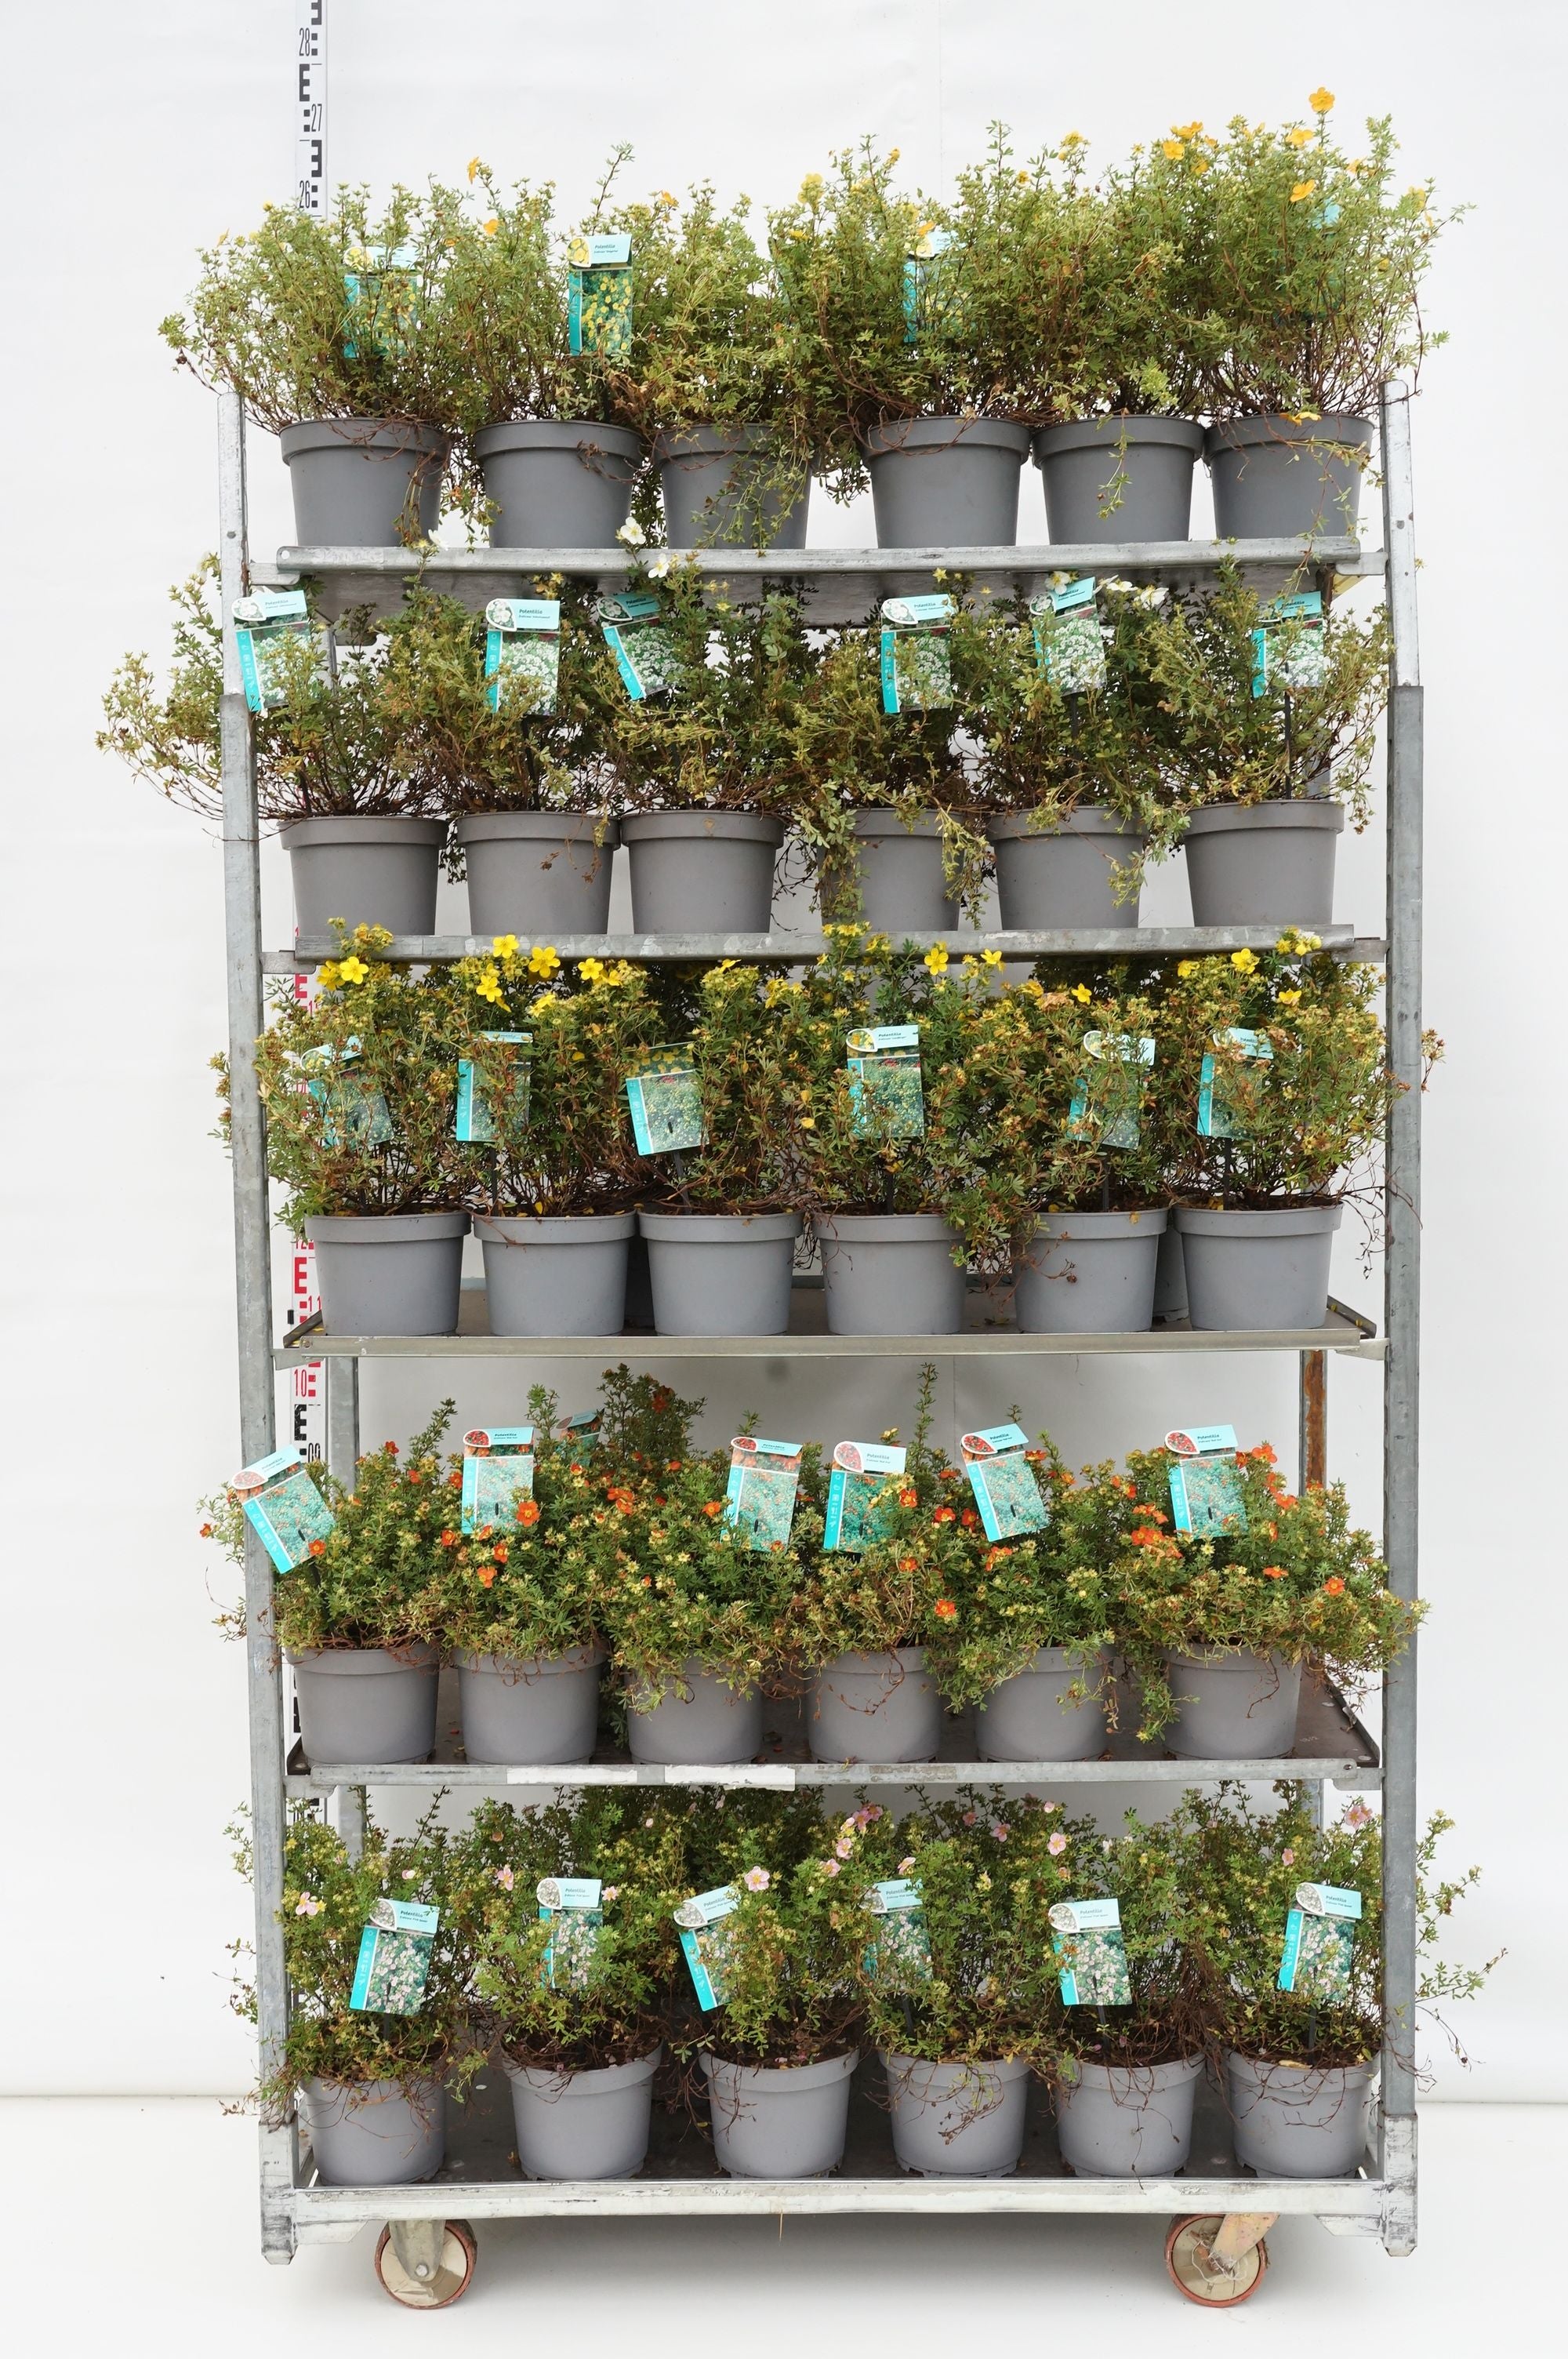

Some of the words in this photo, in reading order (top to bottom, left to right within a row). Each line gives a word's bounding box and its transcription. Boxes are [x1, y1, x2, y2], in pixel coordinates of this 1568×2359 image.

[299, 27, 310, 56] 28
[311, 104, 321, 133] 27
[299, 180, 310, 209] 26
[294, 1369, 307, 1398] 10
